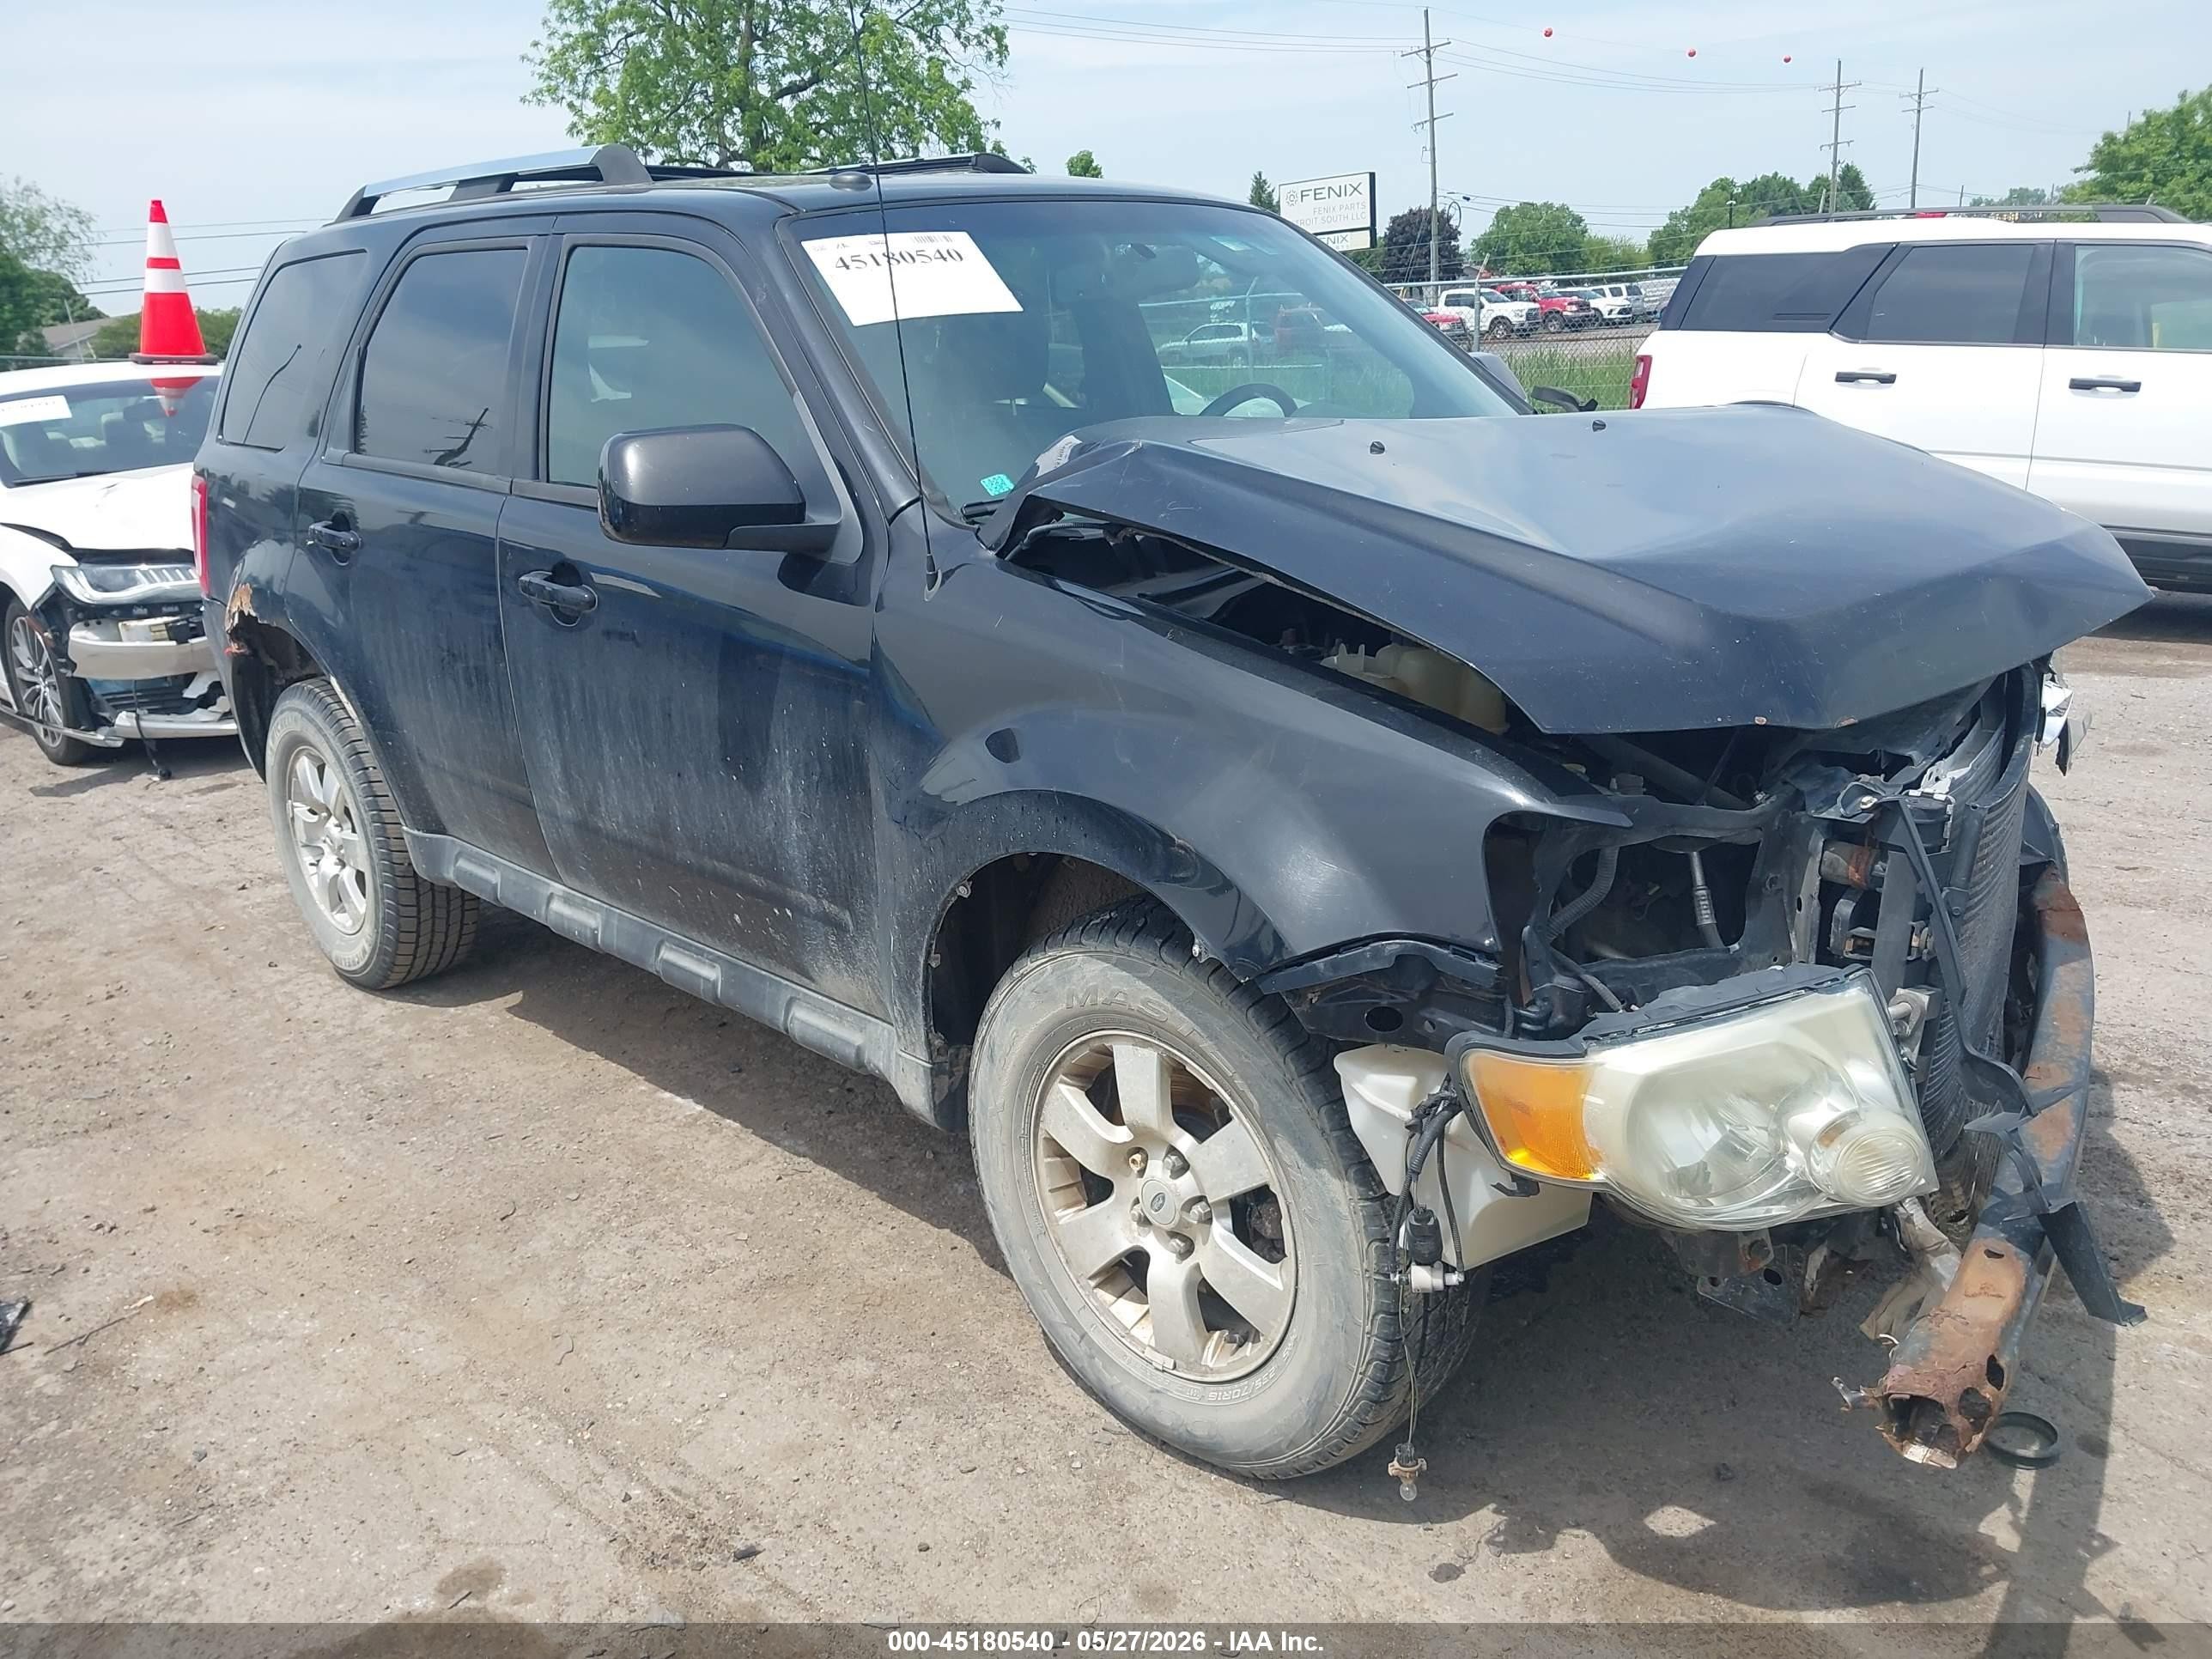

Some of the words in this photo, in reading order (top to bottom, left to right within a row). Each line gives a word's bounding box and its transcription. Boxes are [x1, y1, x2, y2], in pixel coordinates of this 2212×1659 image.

[1300, 181, 1363, 203] FENIX
[1294, 217, 1318, 227] TROIT
[1321, 214, 1348, 225] SOUTH
[1351, 211, 1367, 221] LLC
[1313, 206, 1336, 216] FENIX
[1339, 201, 1366, 213] PARTS
[836, 248, 964, 270] 45180540
[1207, 1365, 1279, 1401] 235/70R16
